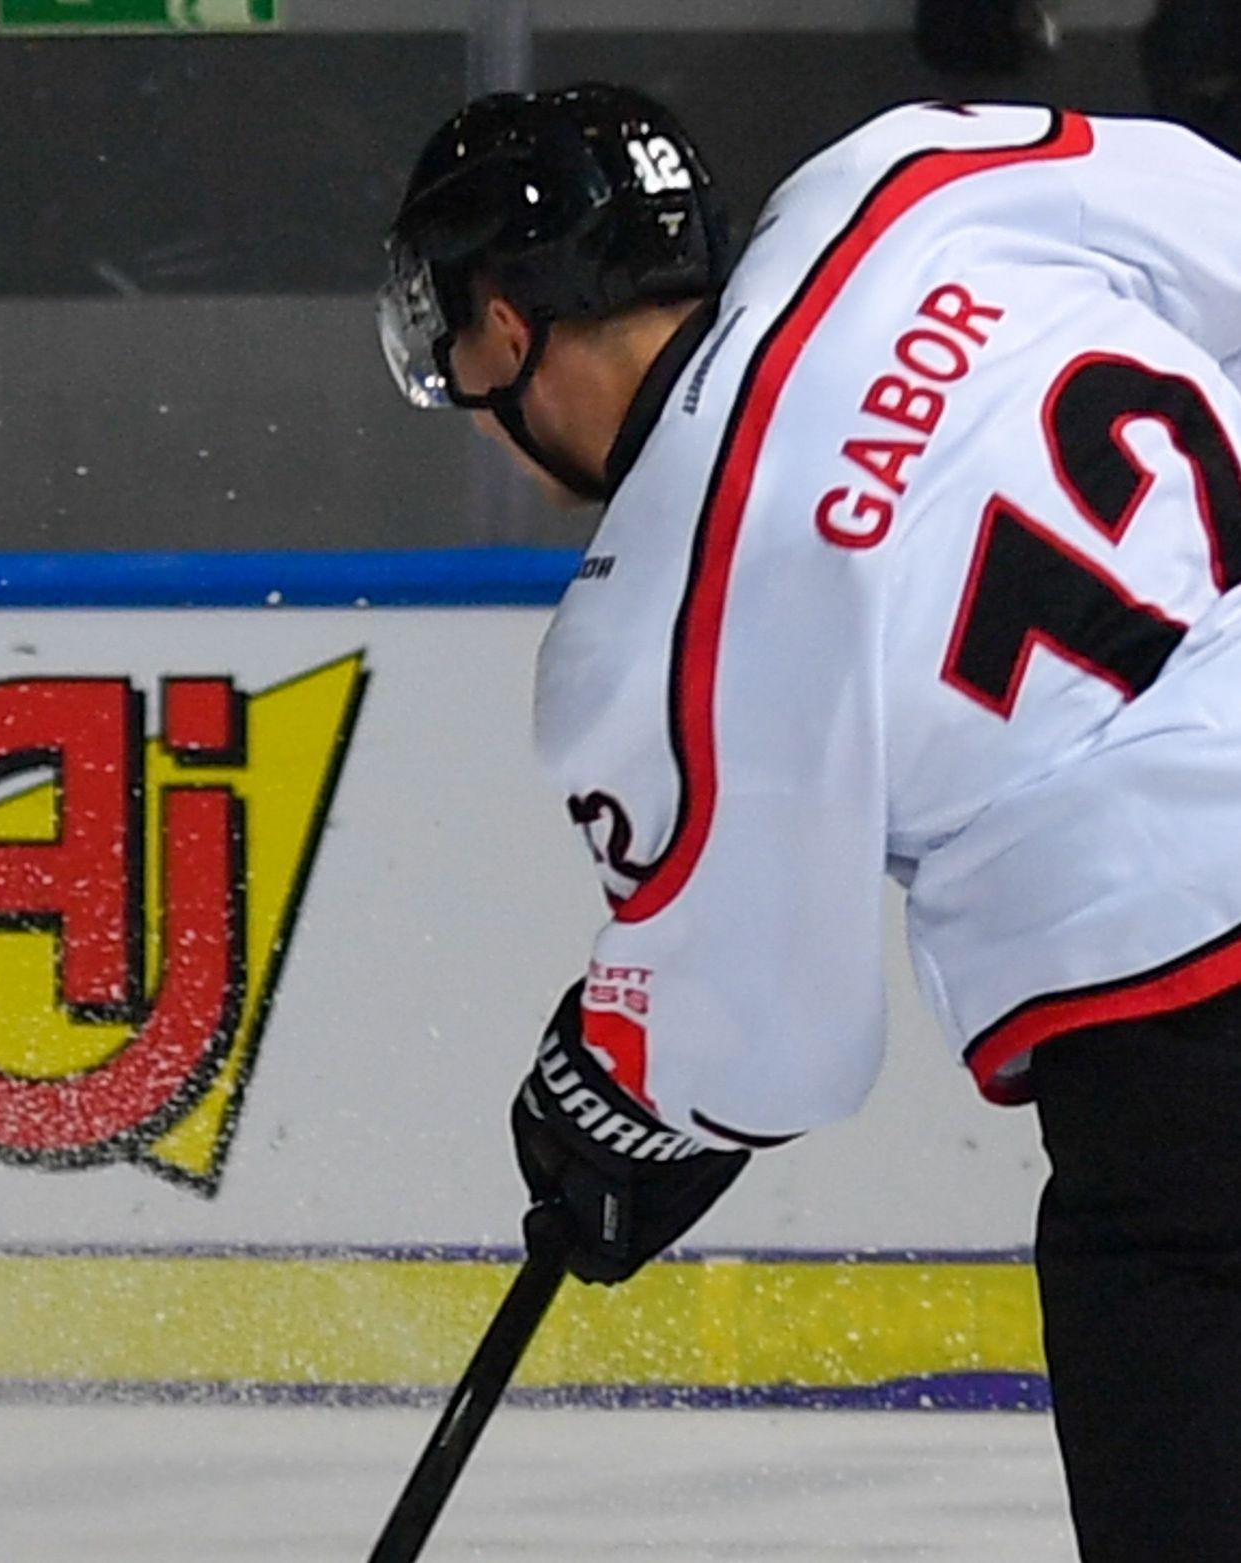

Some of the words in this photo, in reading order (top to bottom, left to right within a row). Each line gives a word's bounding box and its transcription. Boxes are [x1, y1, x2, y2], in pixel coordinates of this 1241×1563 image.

[627, 136, 692, 195] 12
[815, 283, 1005, 549] GABOR
[939, 350, 1241, 722] 12
